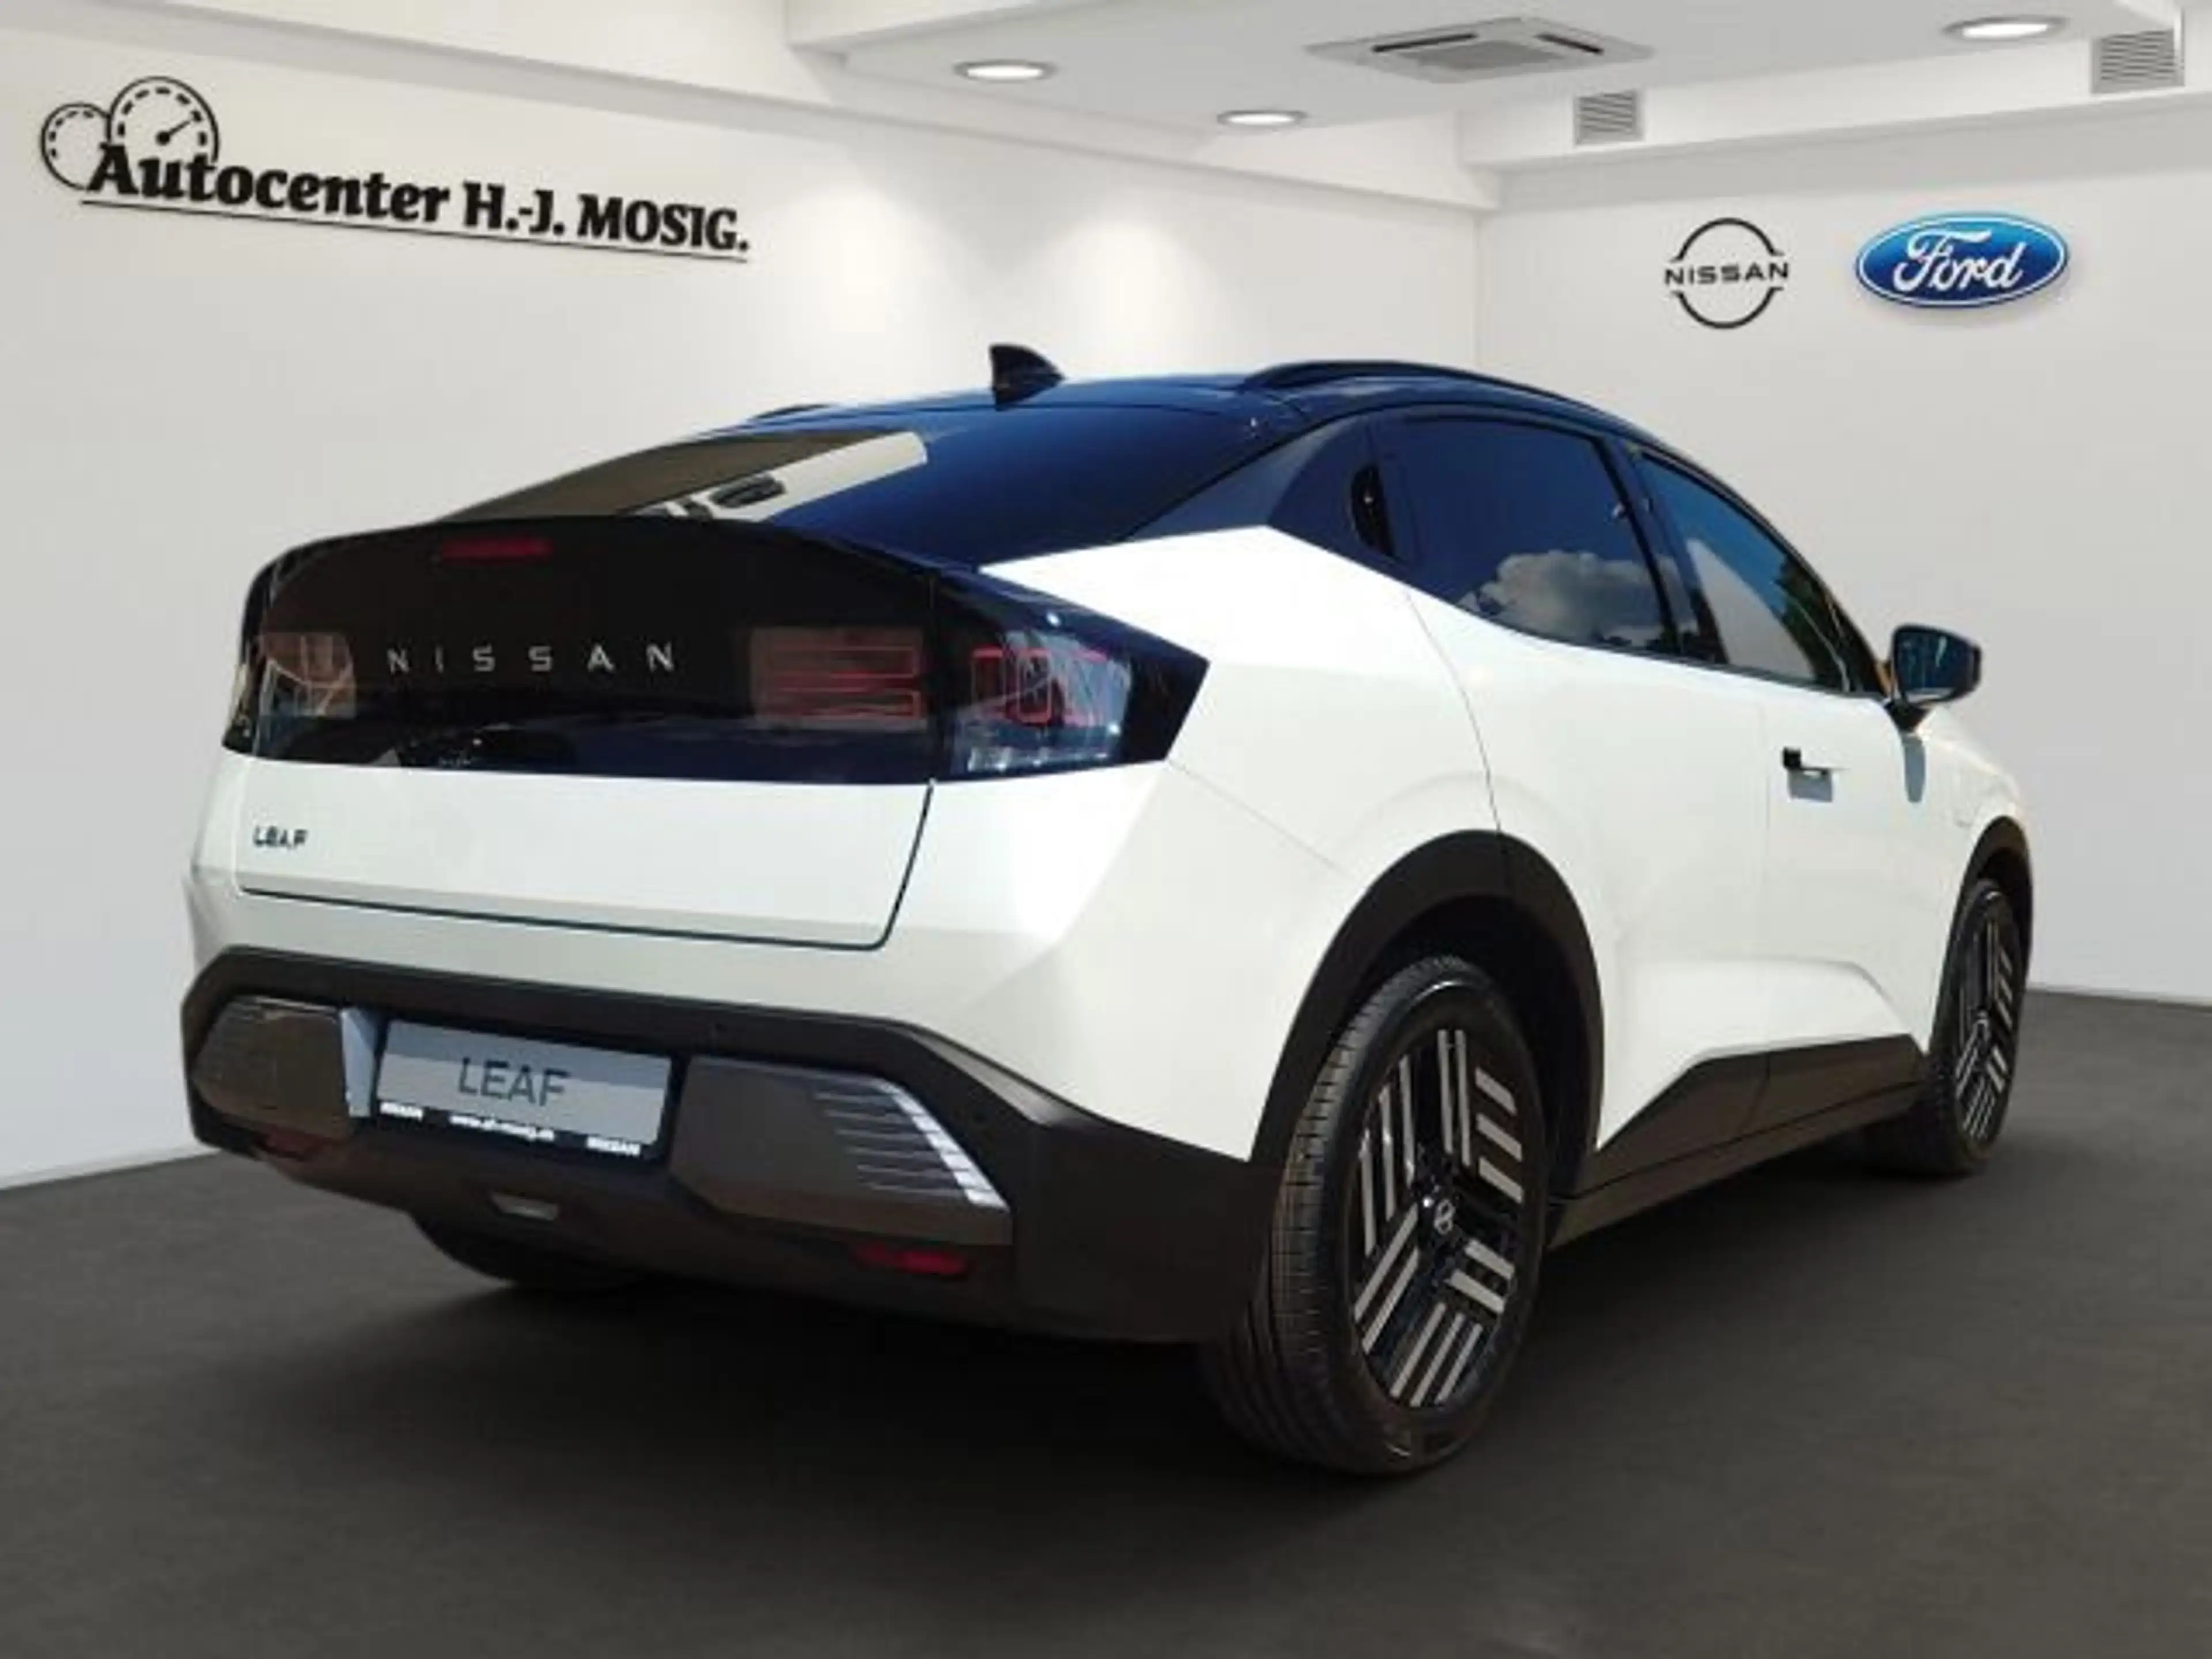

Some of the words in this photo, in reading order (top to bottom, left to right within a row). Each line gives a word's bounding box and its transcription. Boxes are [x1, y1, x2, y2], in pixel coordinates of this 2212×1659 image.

[85, 143, 450, 222] Autocenter
[463, 182, 565, 235] H.-J.
[577, 194, 748, 251] MOSIG.
[1664, 262, 1789, 285] NISSAN
[1893, 229, 2027, 291] Ford
[387, 644, 675, 672] NISSAN
[457, 1057, 570, 1106] LEAF
